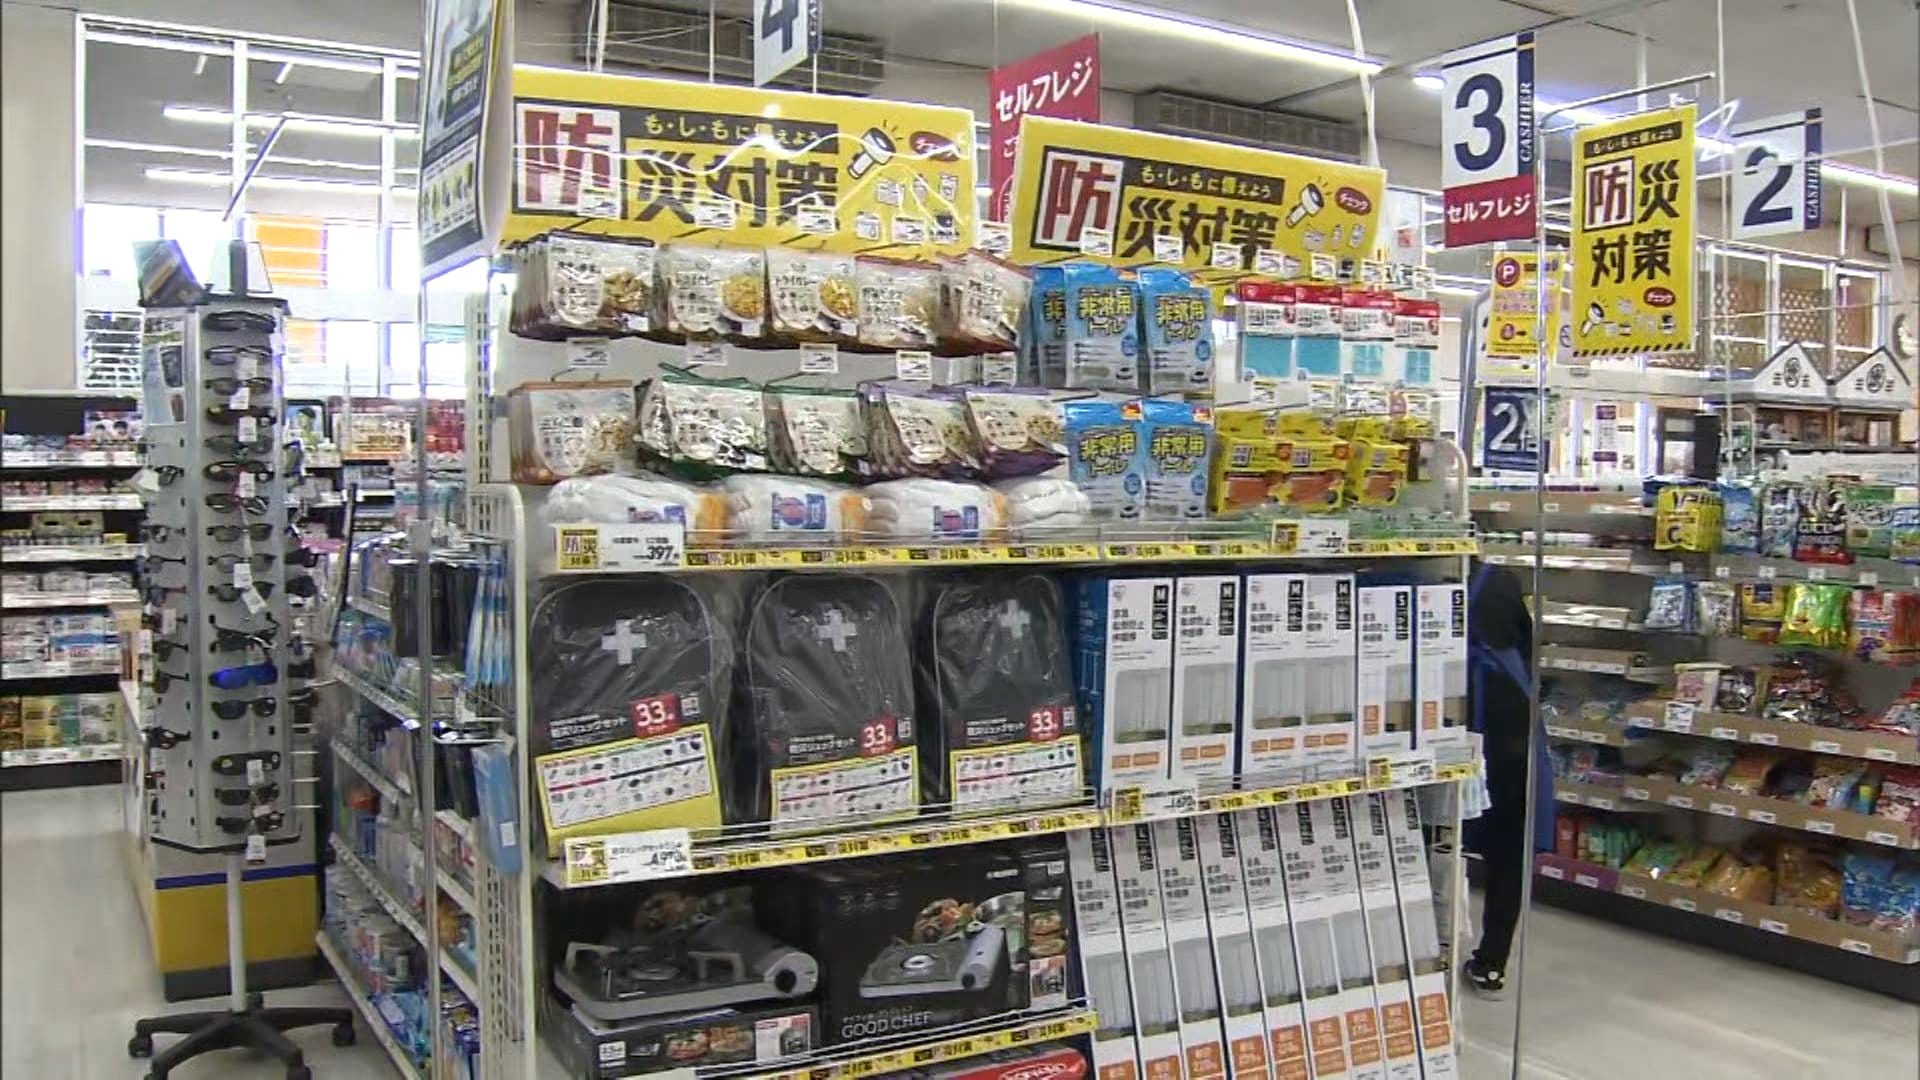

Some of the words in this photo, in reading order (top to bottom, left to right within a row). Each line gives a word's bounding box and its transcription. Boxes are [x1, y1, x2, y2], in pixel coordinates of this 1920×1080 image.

[762, 0, 798, 54] 4
[996, 57, 1093, 122] セルフレジ
[1454, 74, 1506, 171] 3
[1519, 82, 1533, 162] CASHIER
[1447, 194, 1532, 224] セルフレジ
[1588, 160, 1680, 225] 防災
[1742, 146, 1793, 226] 2
[1591, 229, 1671, 288] 対策
[1490, 403, 1520, 450] 2
[648, 545, 672, 560] 397
[636, 702, 666, 727] 33
[864, 724, 888, 748] 33
[1031, 712, 1052, 732] 33
[841, 1020, 888, 1038] GOOD
[891, 1011, 930, 1029] CHEF
